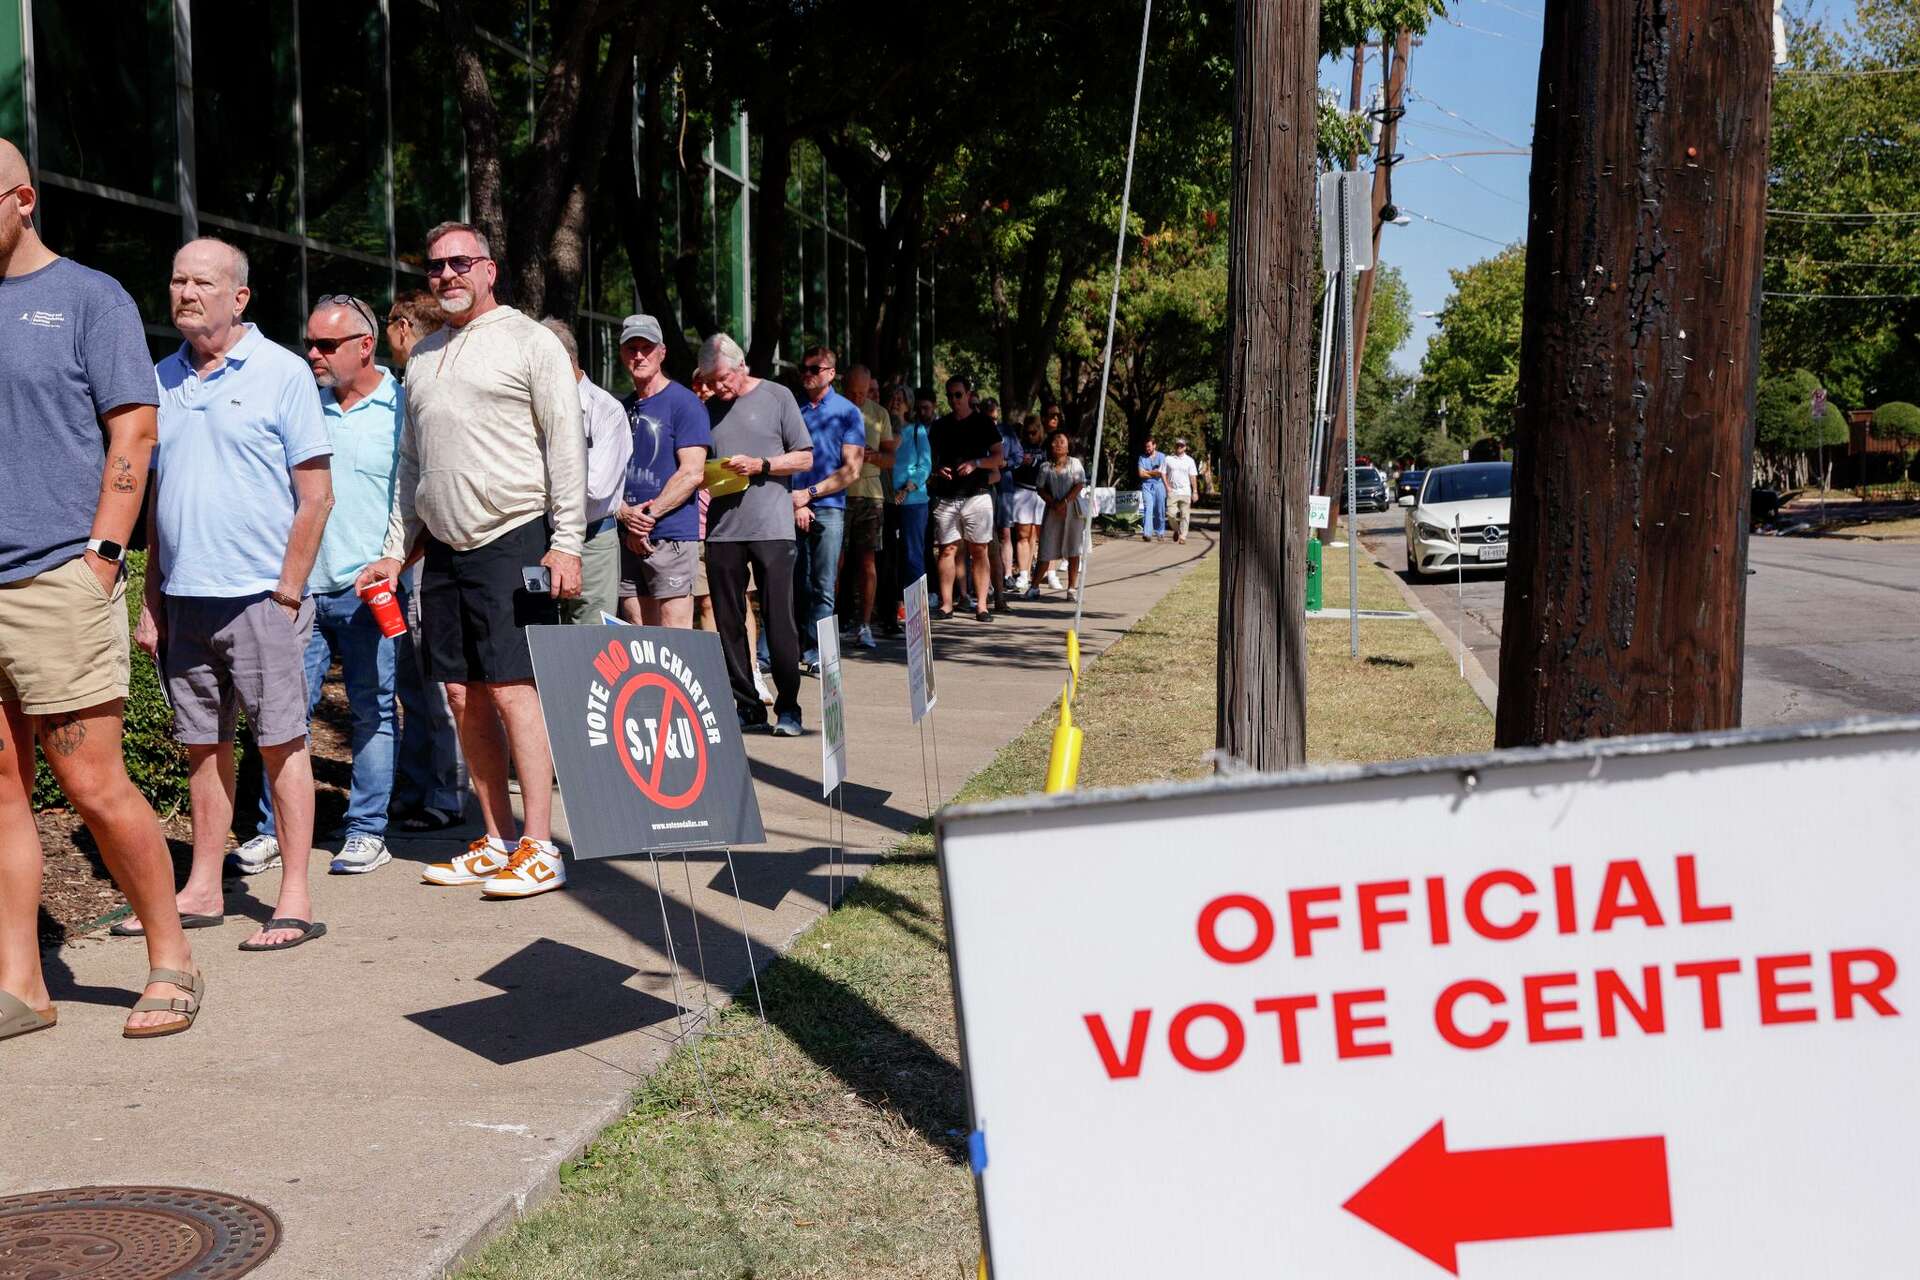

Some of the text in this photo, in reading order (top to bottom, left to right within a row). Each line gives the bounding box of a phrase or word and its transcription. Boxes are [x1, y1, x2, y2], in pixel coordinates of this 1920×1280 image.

[586, 640, 721, 747] VOTE NO ON CHARTER
[1196, 855, 1733, 965] OFFICIAL
[1084, 948, 1898, 1080] VOTE CENTER
